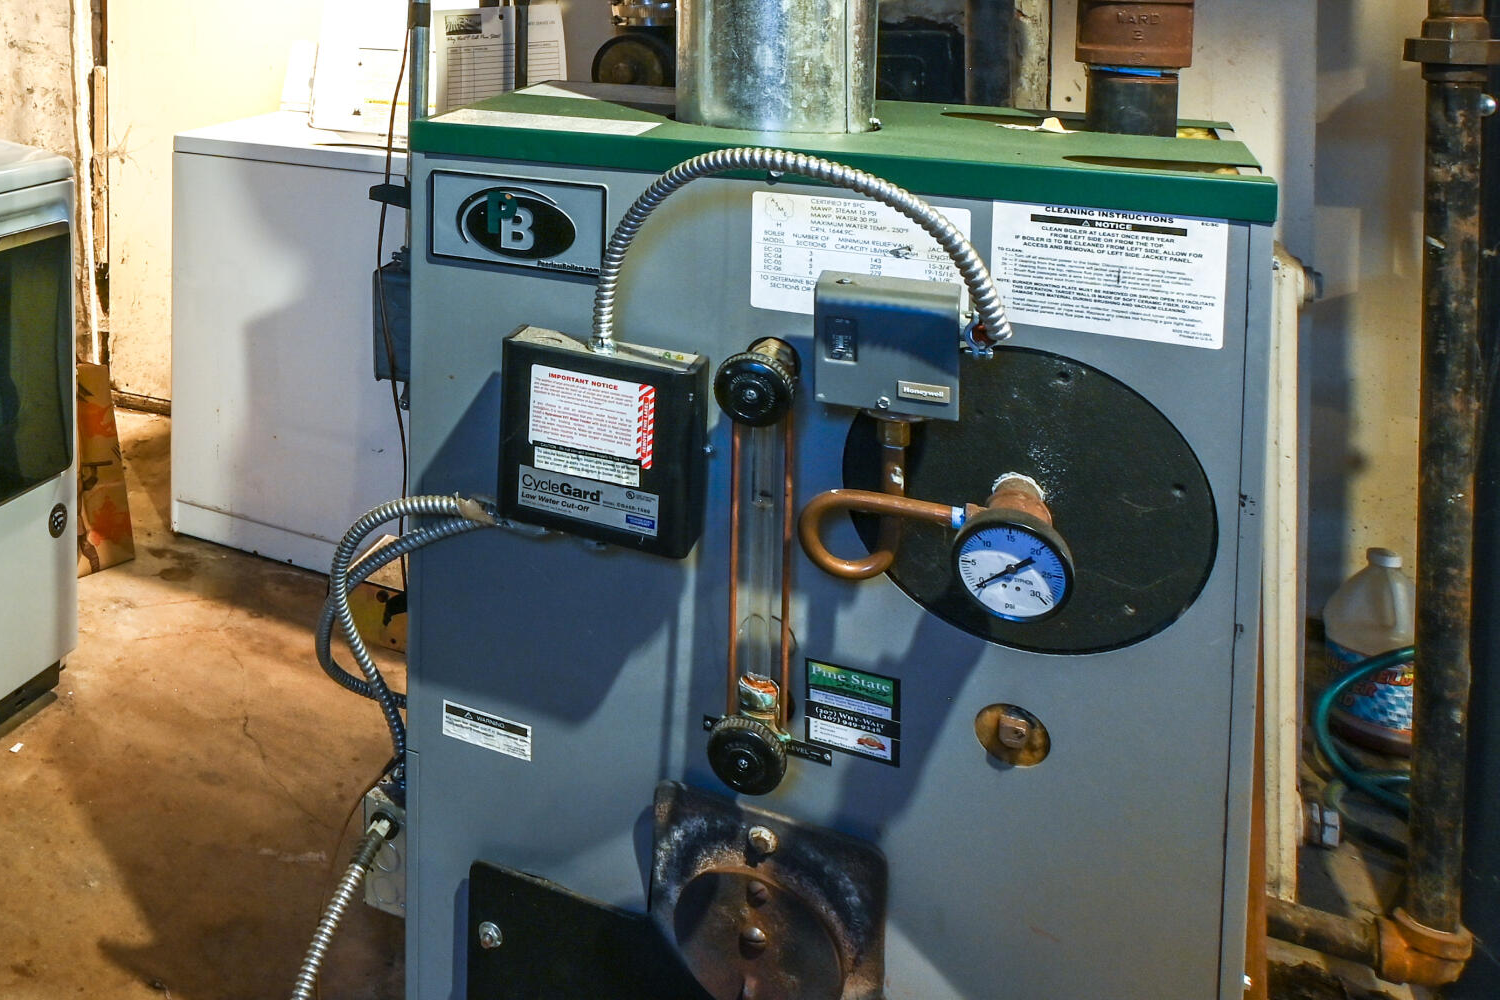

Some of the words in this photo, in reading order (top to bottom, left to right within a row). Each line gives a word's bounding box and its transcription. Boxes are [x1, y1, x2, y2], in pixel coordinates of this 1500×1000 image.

[1045, 206, 1094, 216] CLEANING
[1099, 211, 1174, 224] INSTRUCTIONS
[1095, 221, 1132, 230] NOTICE
[796, 240, 827, 248] SECTIONS
[835, 244, 867, 252] CAPACITY
[537, 260, 599, 273] PeerlessBoilers.com
[770, 276, 803, 284] DETERMINE
[549, 372, 589, 386] IMPORTANT
[592, 381, 618, 392] NOTICE
[903, 386, 944, 398] Honeywell
[522, 474, 600, 502] CycleGard
[522, 491, 536, 501] Low
[538, 495, 559, 506] Water
[561, 500, 590, 513] Cut-Off
[983, 540, 991, 548] 10
[812, 665, 847, 682] Pine
[851, 674, 890, 692] State
[477, 715, 505, 729] WARNING
